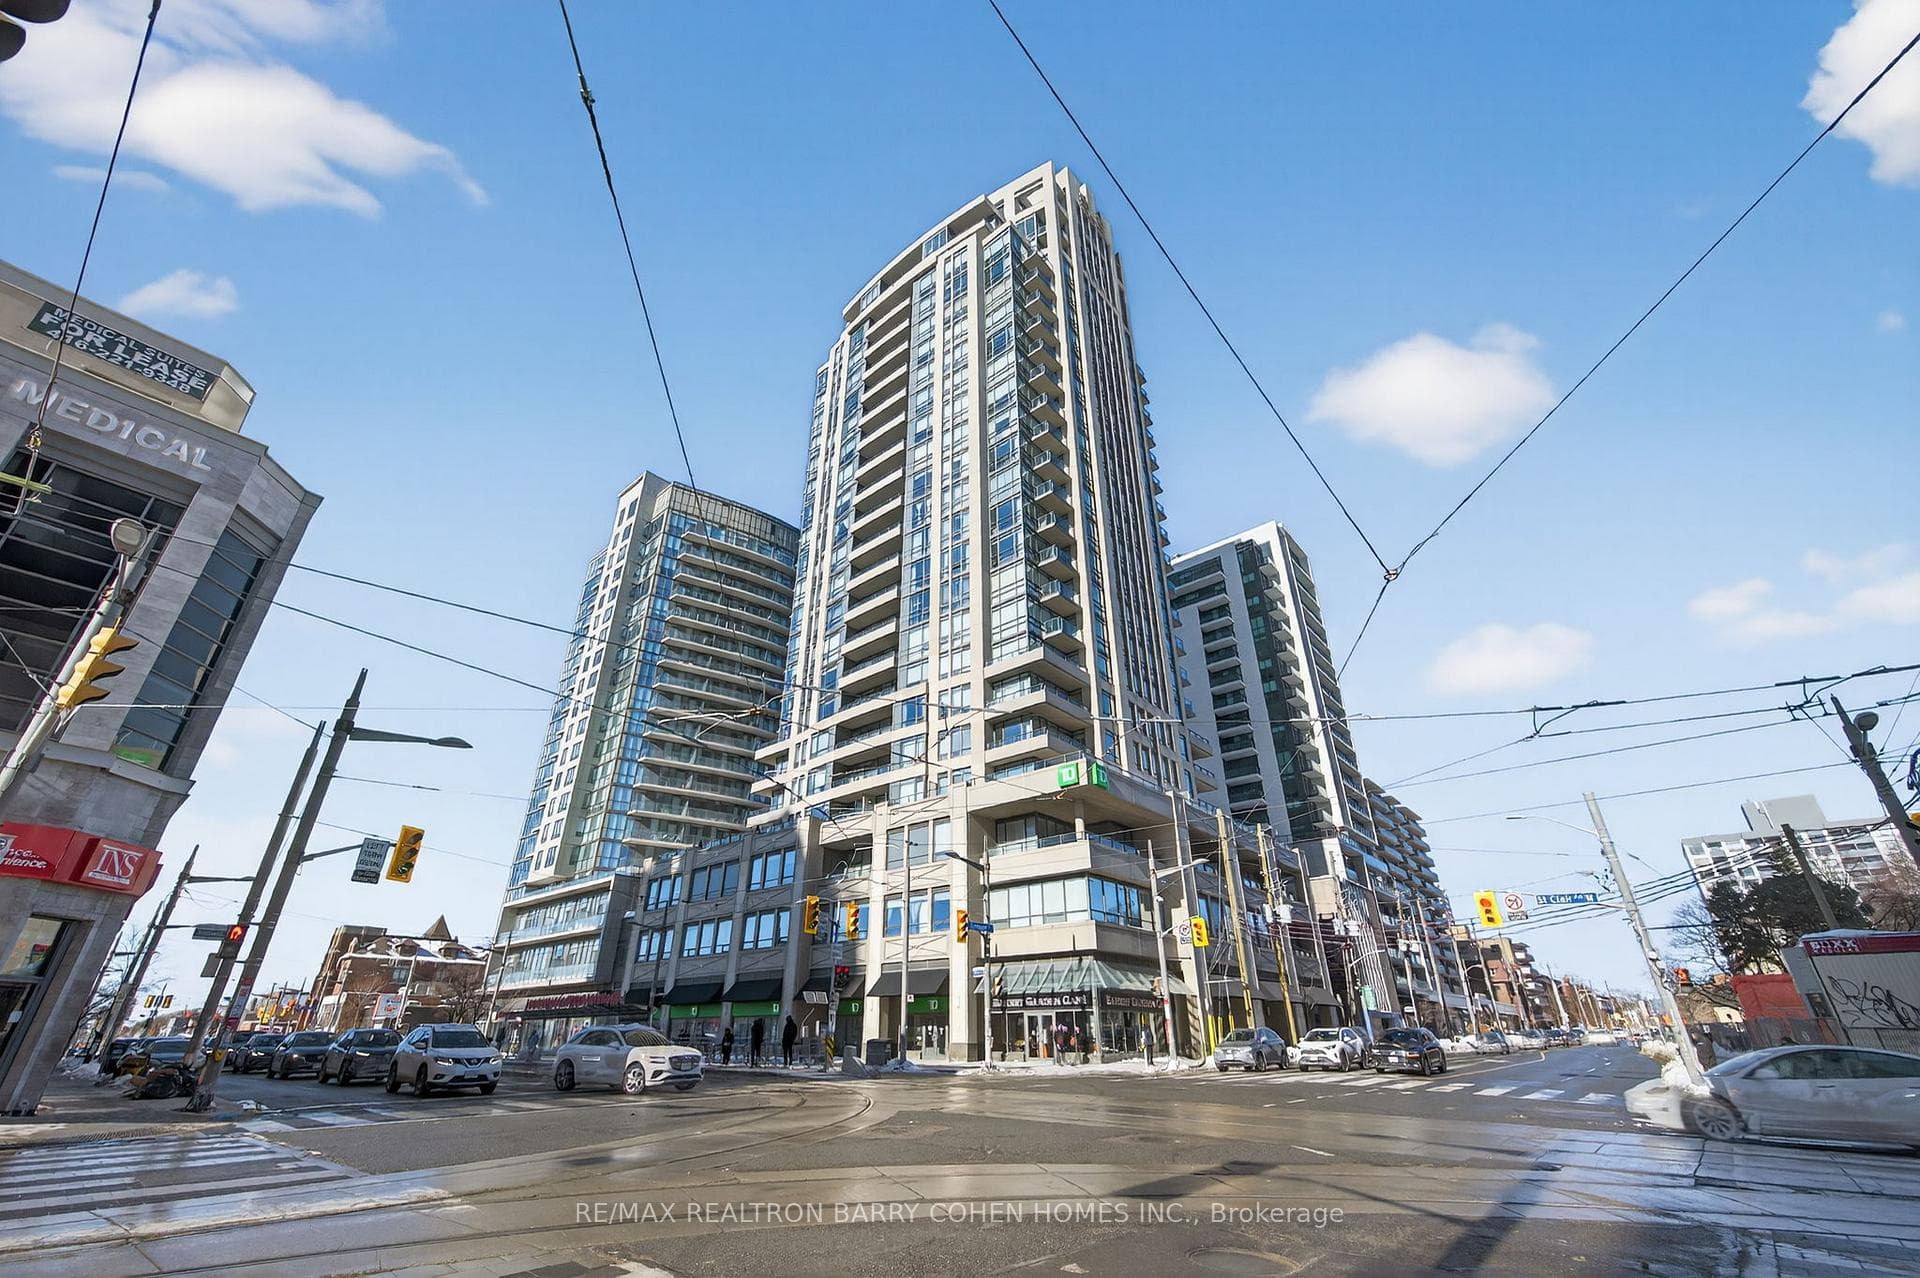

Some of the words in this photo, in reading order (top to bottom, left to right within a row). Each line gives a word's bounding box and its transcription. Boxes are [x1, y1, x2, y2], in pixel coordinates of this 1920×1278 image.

[40, 312, 106, 348] FOR
[114, 343, 208, 391] LEASE
[54, 308, 138, 351] MEDICAL
[144, 347, 206, 378] SUITES
[13, 380, 212, 472] MEDICAL
